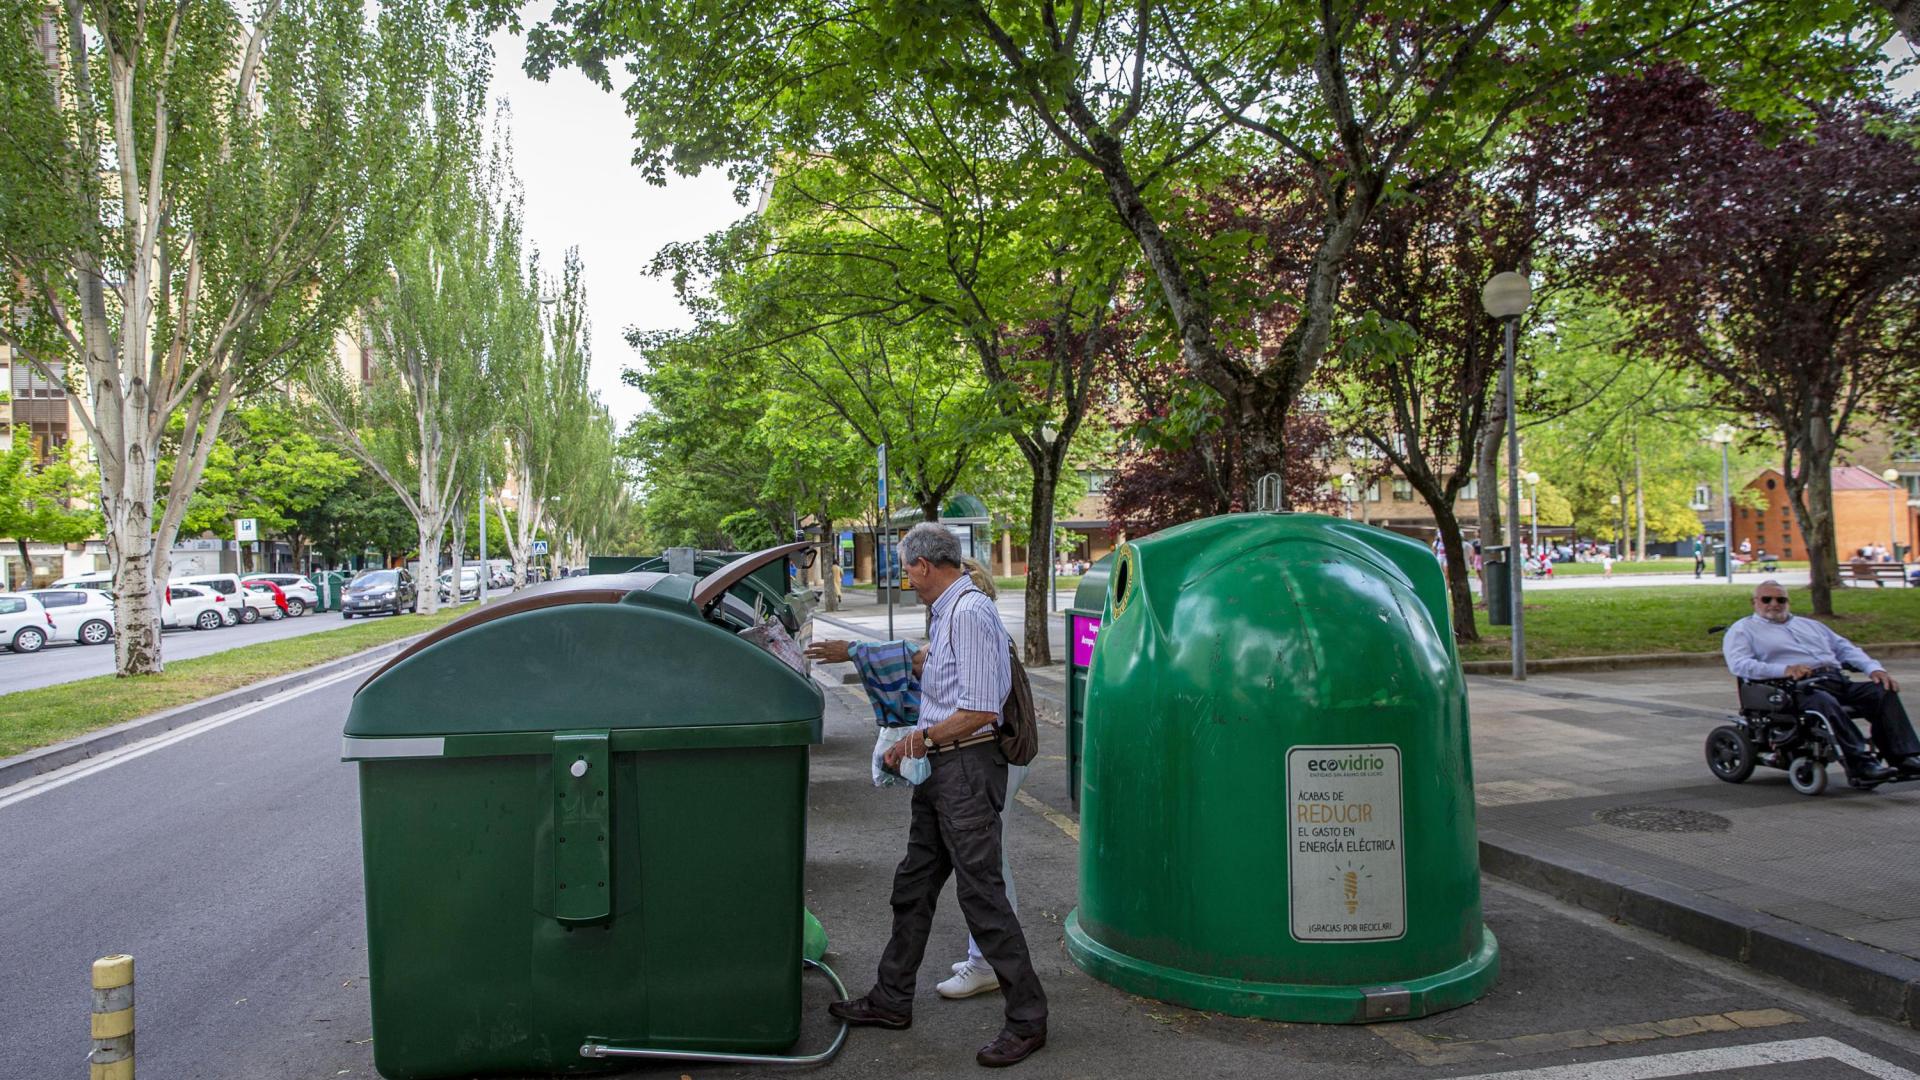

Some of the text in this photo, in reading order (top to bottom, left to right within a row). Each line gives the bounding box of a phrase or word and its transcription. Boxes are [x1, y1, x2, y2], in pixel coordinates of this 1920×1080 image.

[1308, 753, 1384, 771] ecovidrio
[1332, 791, 1344, 801] DE
[1297, 803, 1373, 823] REDUCIR
[1298, 827, 1355, 837] EL GASTO EN
[1299, 838, 1396, 853] ENERGÍA ELÉCTRICA
[1308, 922, 1392, 934] ¡GRACIAS POR RECICLAR!
